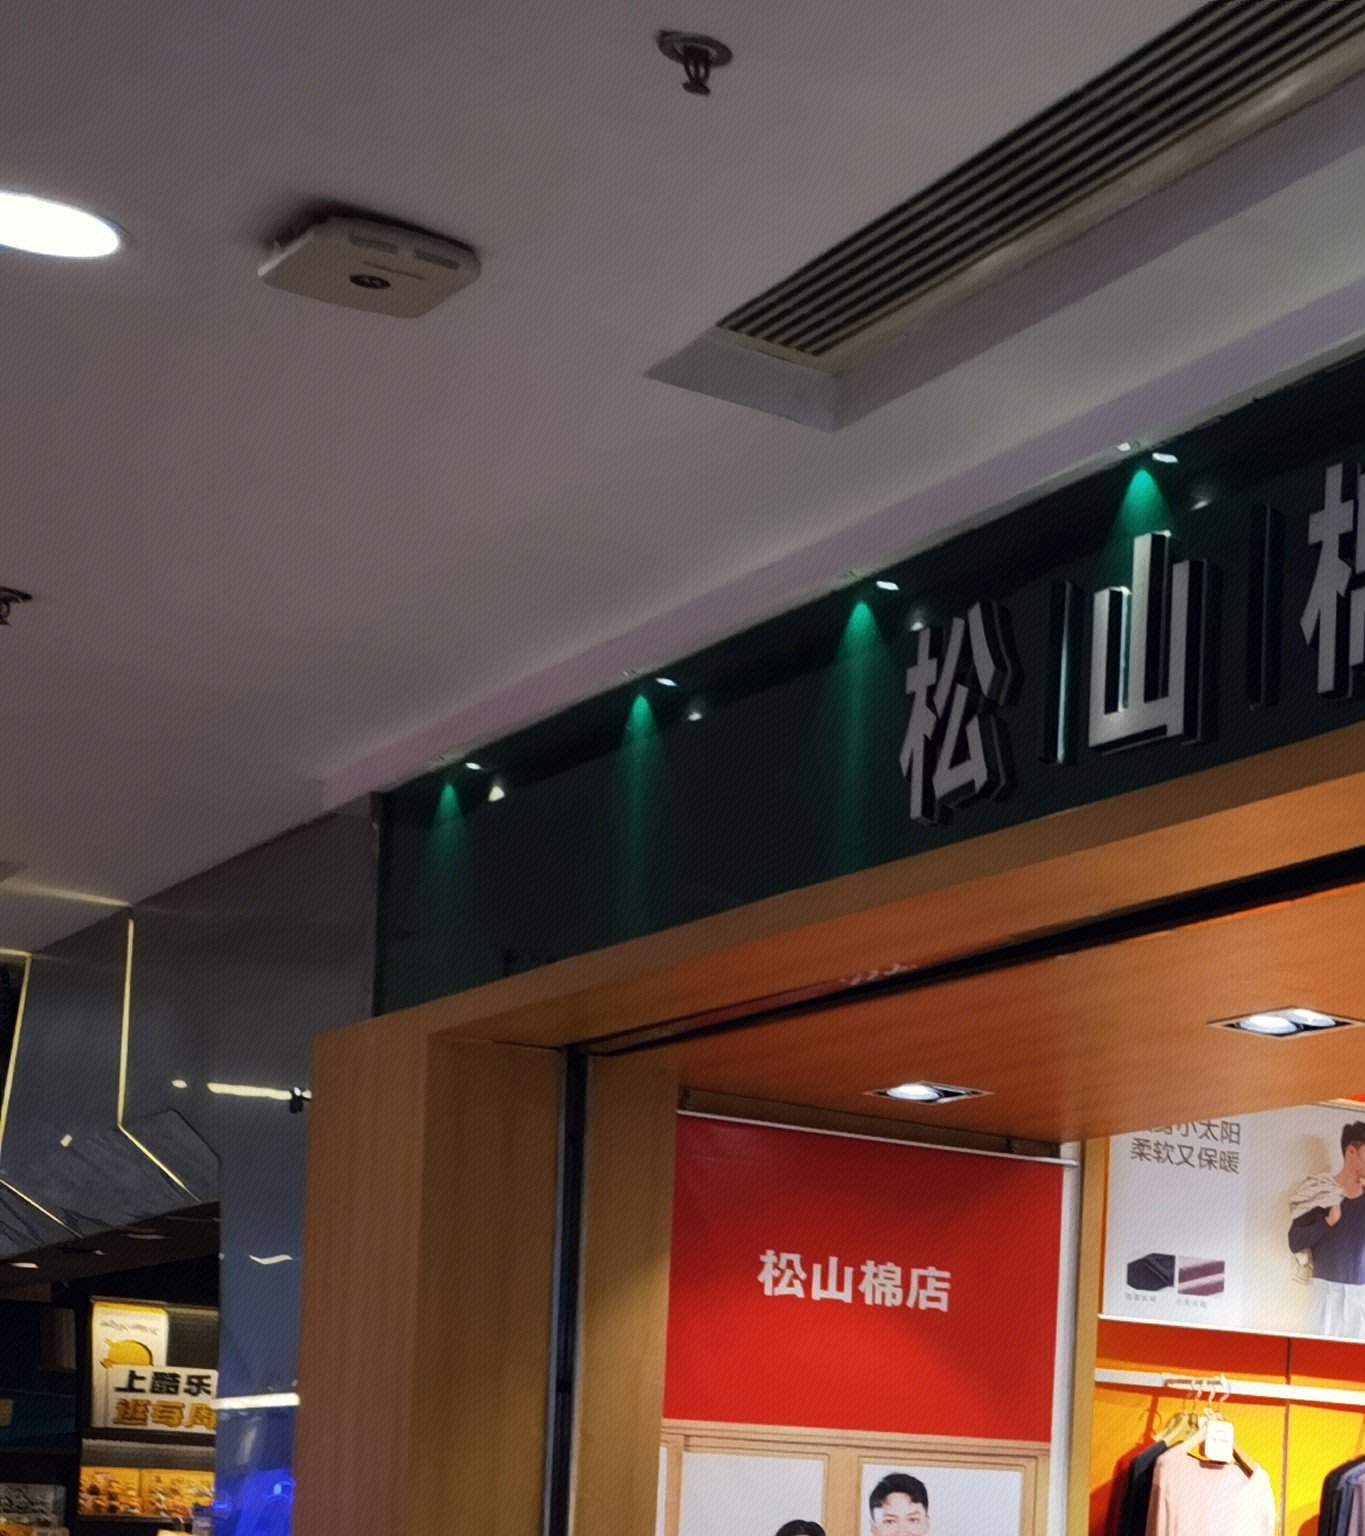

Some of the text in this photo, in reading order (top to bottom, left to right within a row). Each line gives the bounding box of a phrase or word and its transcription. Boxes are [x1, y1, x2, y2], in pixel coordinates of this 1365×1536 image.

[1129, 1137, 1240, 1175] 柔软又保暖
[757, 1248, 952, 1313] 松山棉店
